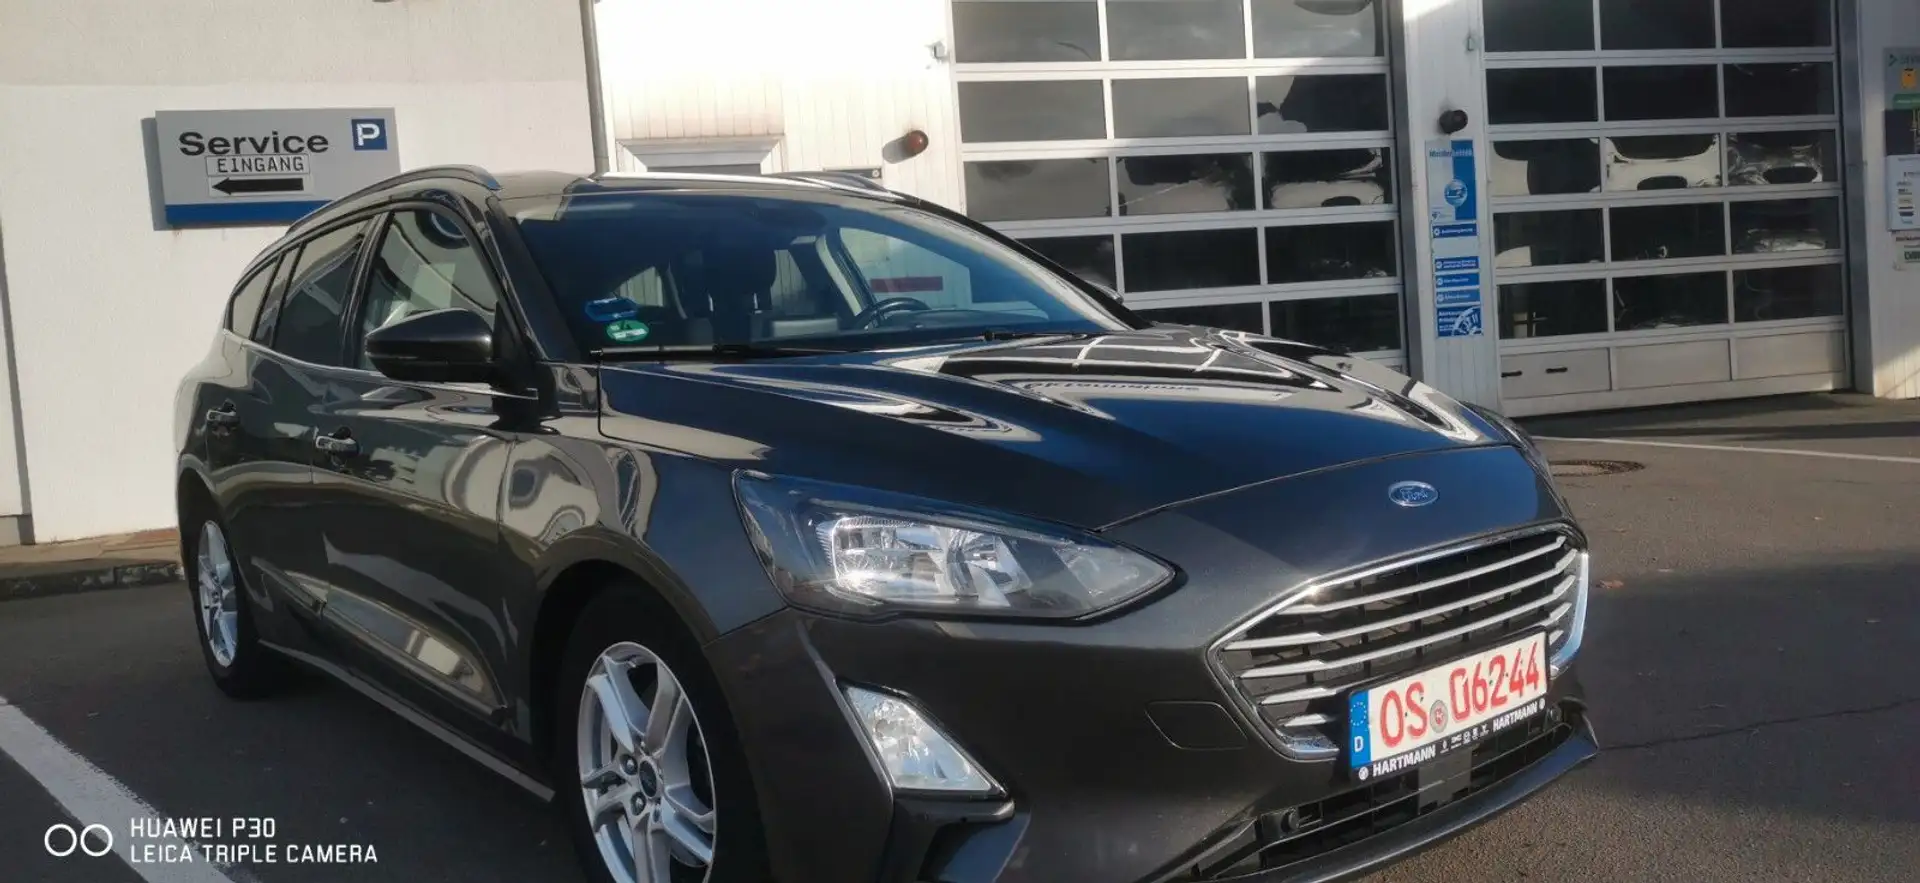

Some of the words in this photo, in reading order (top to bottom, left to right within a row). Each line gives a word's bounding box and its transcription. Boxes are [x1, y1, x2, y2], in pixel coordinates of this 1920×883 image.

[178, 131, 329, 156] Service
[355, 123, 381, 146] P
[217, 156, 304, 173] EINGANG
[1380, 681, 1428, 748] OS
[1492, 702, 1538, 732] HARTMANN
[1354, 735, 1364, 752] D
[1372, 745, 1437, 777] HARTMANN
